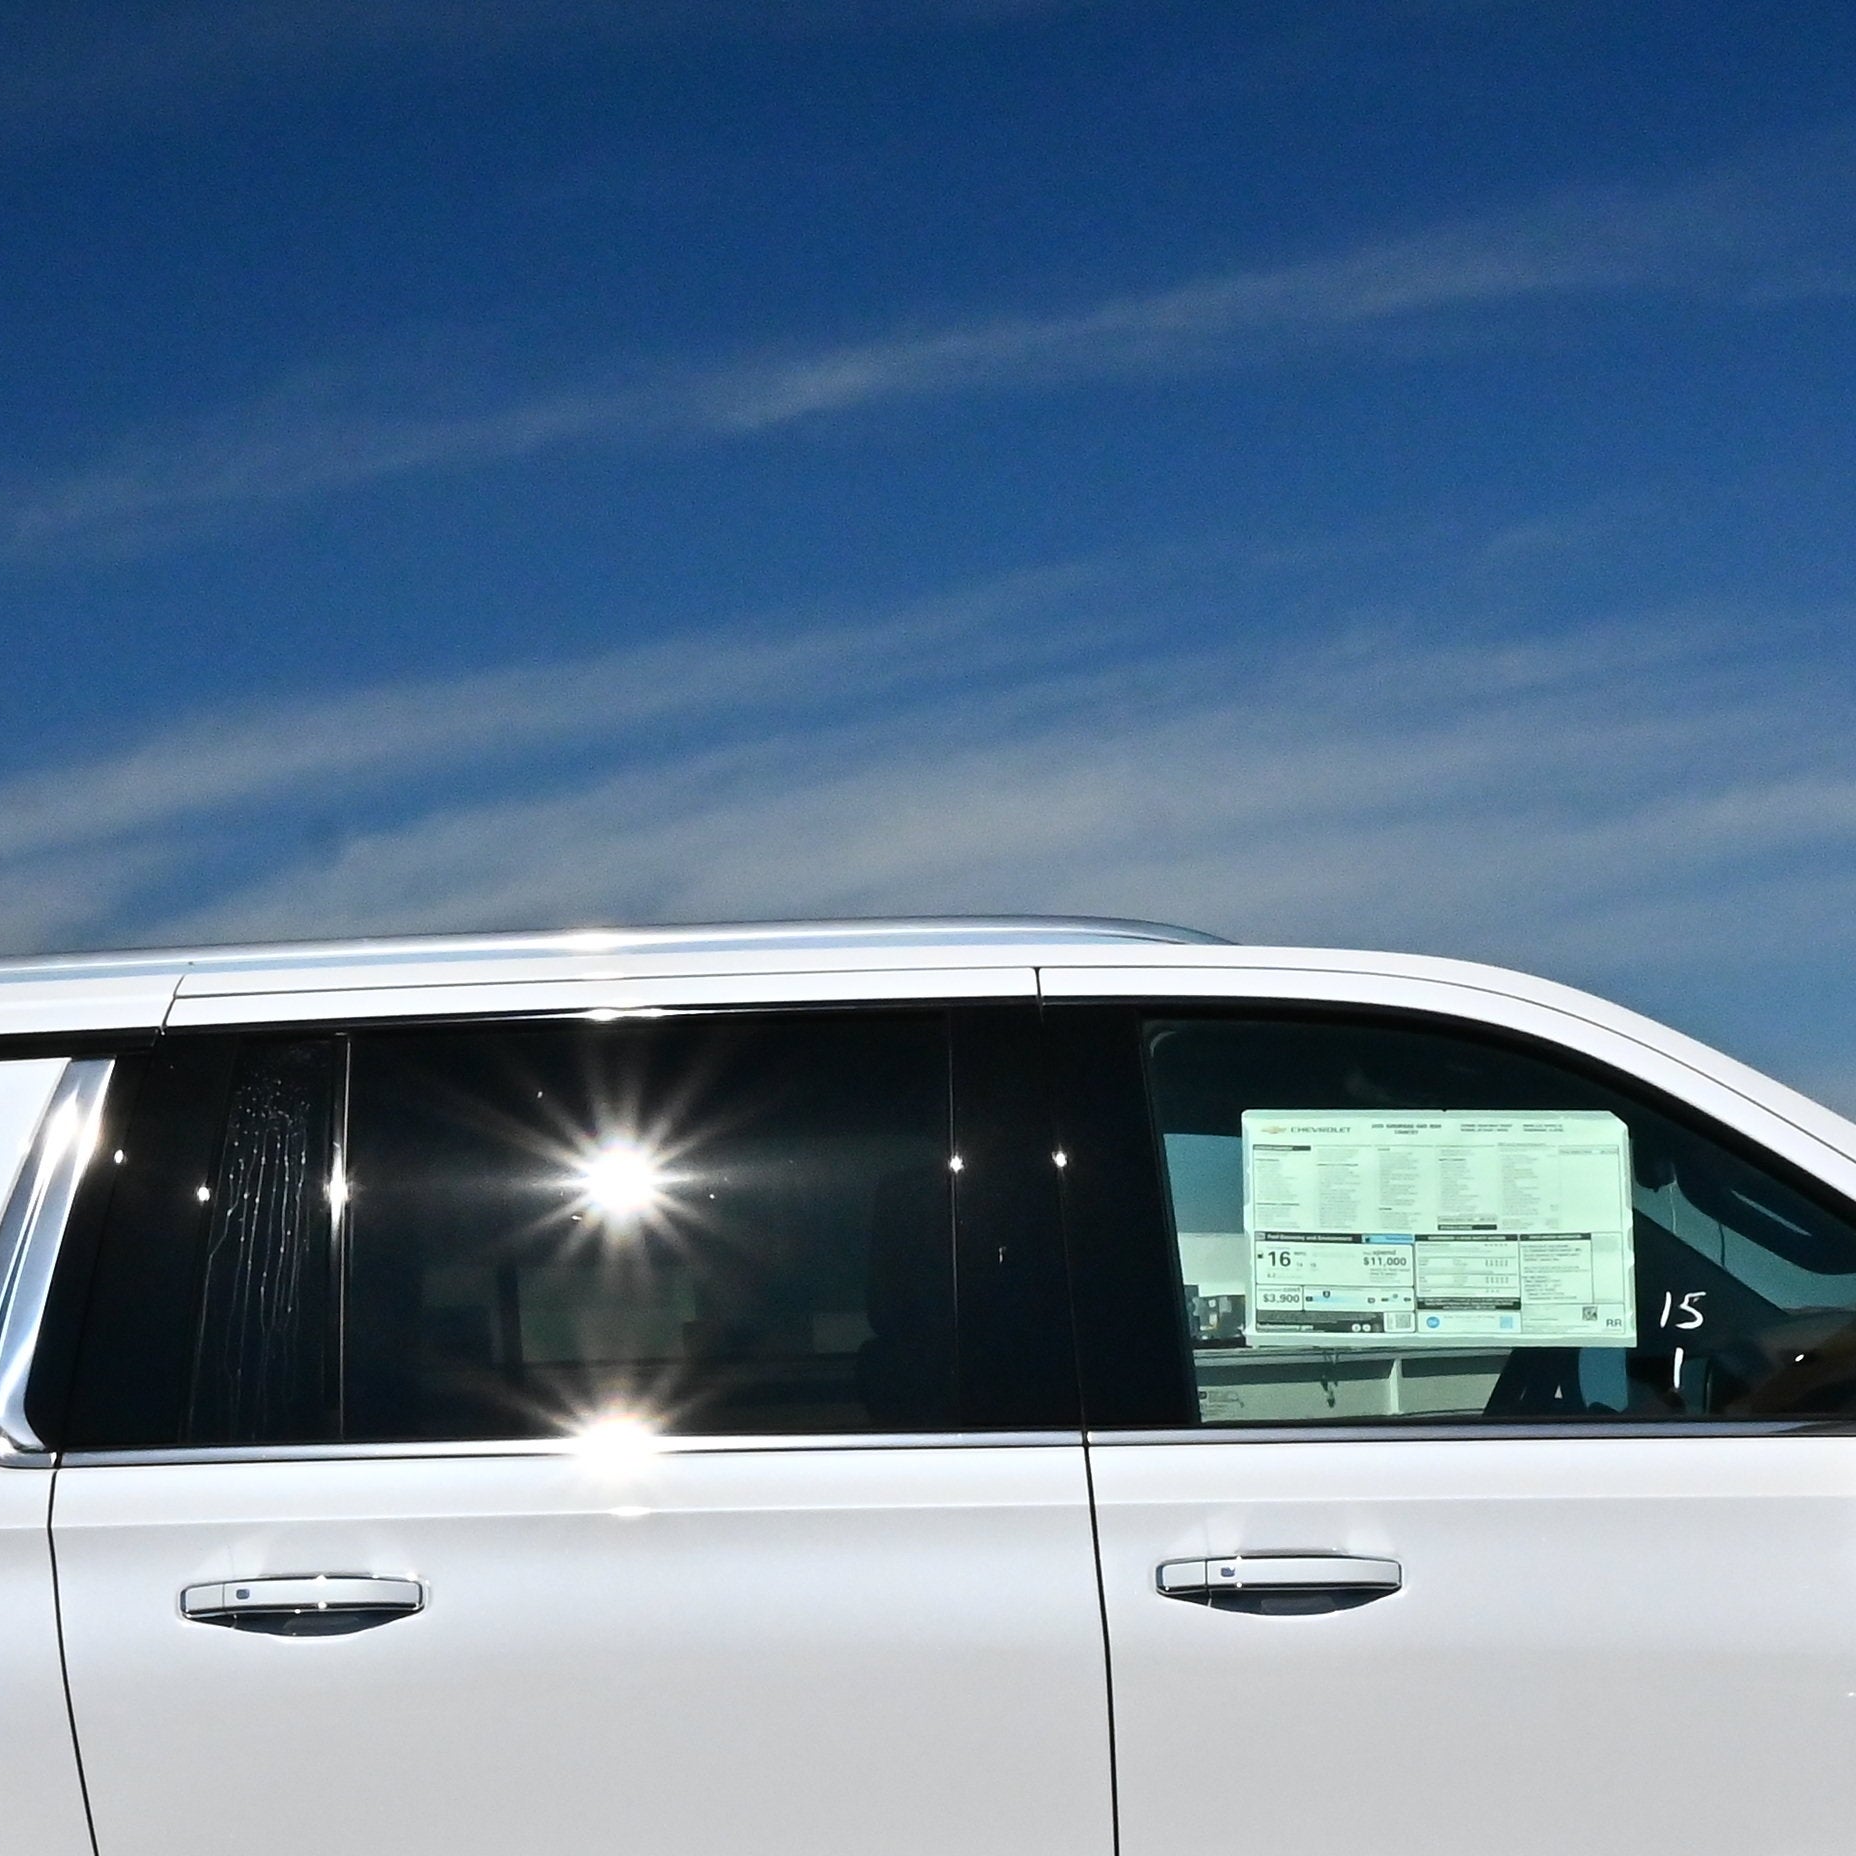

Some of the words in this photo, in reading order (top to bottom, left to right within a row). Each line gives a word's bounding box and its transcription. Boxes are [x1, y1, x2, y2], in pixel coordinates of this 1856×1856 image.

[1290, 1126, 1352, 1134] CHEVROLET
[1268, 1251, 1292, 1267] 16
[1363, 1256, 1407, 1267] $11,000
[1263, 1293, 1300, 1304] $3,900
[1660, 1291, 1707, 1329] 15
[1606, 1318, 1622, 1327] RR
